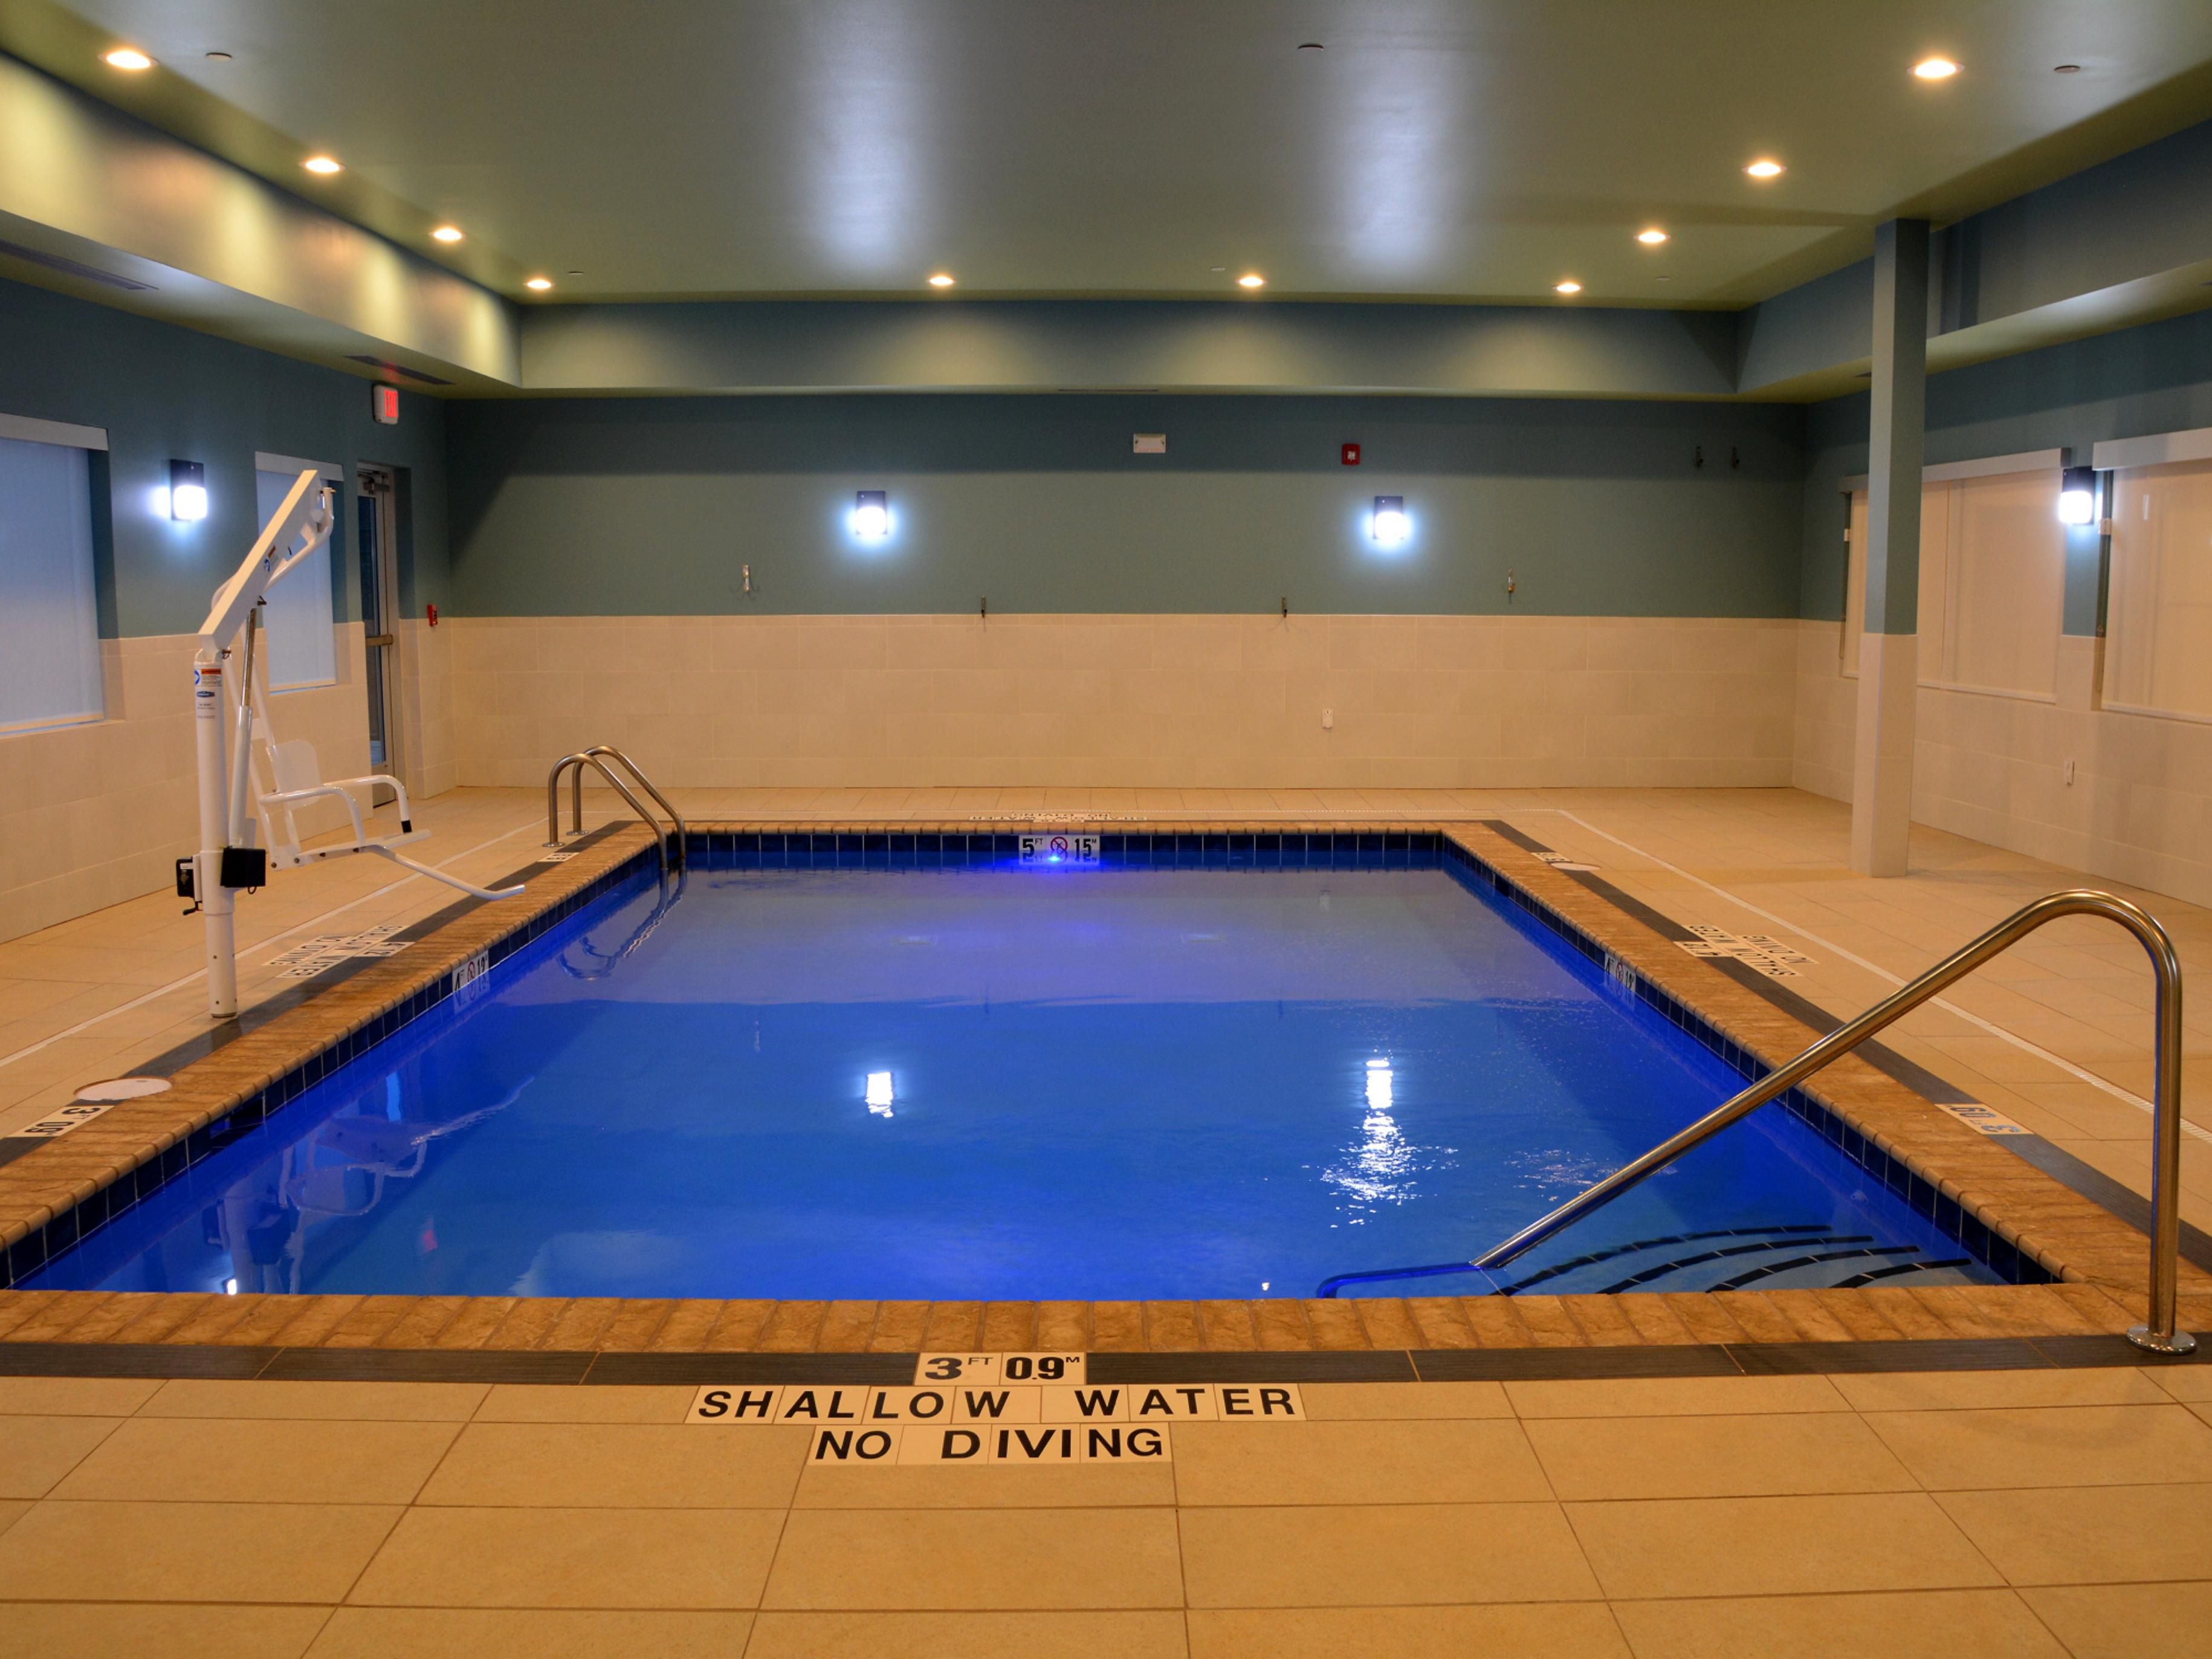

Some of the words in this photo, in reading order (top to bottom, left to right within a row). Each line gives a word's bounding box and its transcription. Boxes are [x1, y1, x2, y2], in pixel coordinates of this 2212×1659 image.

[699, 1390, 1010, 1419] SHALLOW
[1075, 1388, 1295, 1415] WATER
[815, 1430, 892, 1460] NO
[941, 1429, 1162, 1459] DIVING
